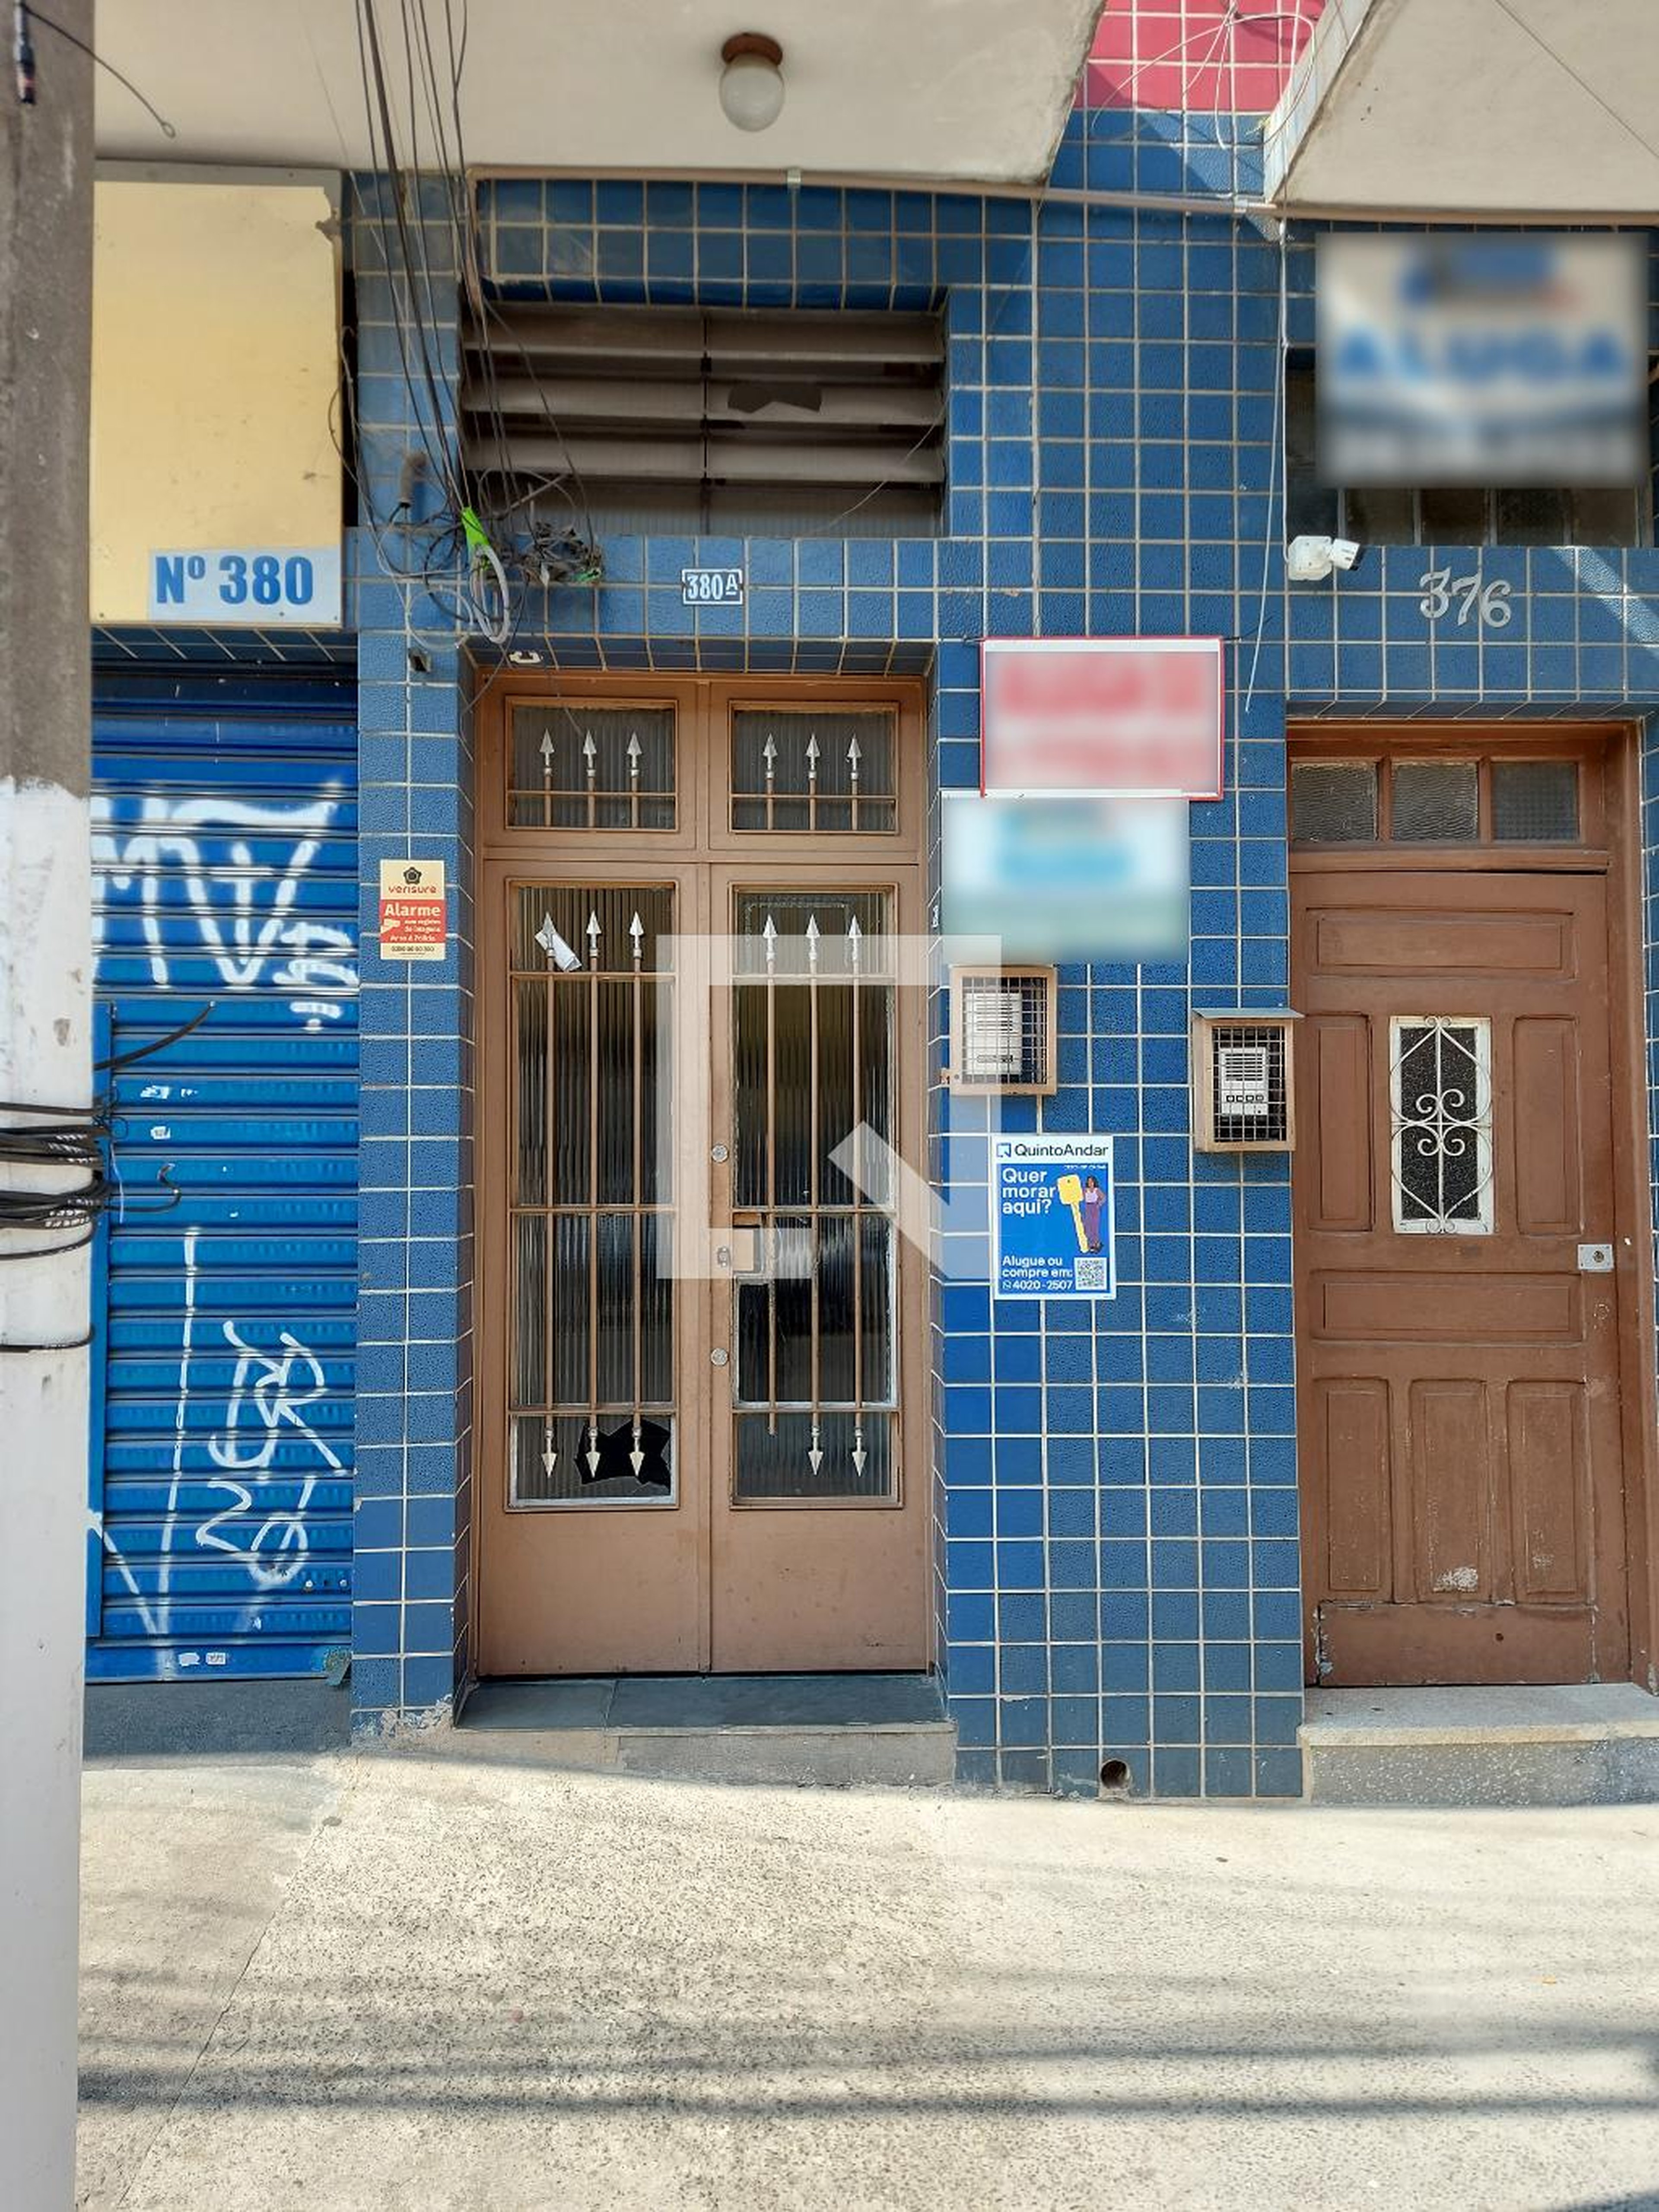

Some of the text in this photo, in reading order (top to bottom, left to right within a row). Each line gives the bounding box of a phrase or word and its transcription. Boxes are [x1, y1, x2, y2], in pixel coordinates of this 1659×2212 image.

[219, 555, 313, 605] 380
[687, 573, 738, 600] 380A
[1419, 566, 1511, 628] 376
[384, 902, 441, 917] Alarme
[1014, 1143, 1109, 1156] QuintoAndar
[1002, 1168, 1048, 1184] Quer
[1002, 1187, 1056, 1198] morar
[1002, 1199, 1052, 1218] aqui?
[1002, 1255, 1063, 1268] Alugue ou
[1002, 1268, 1073, 1279] compre em:
